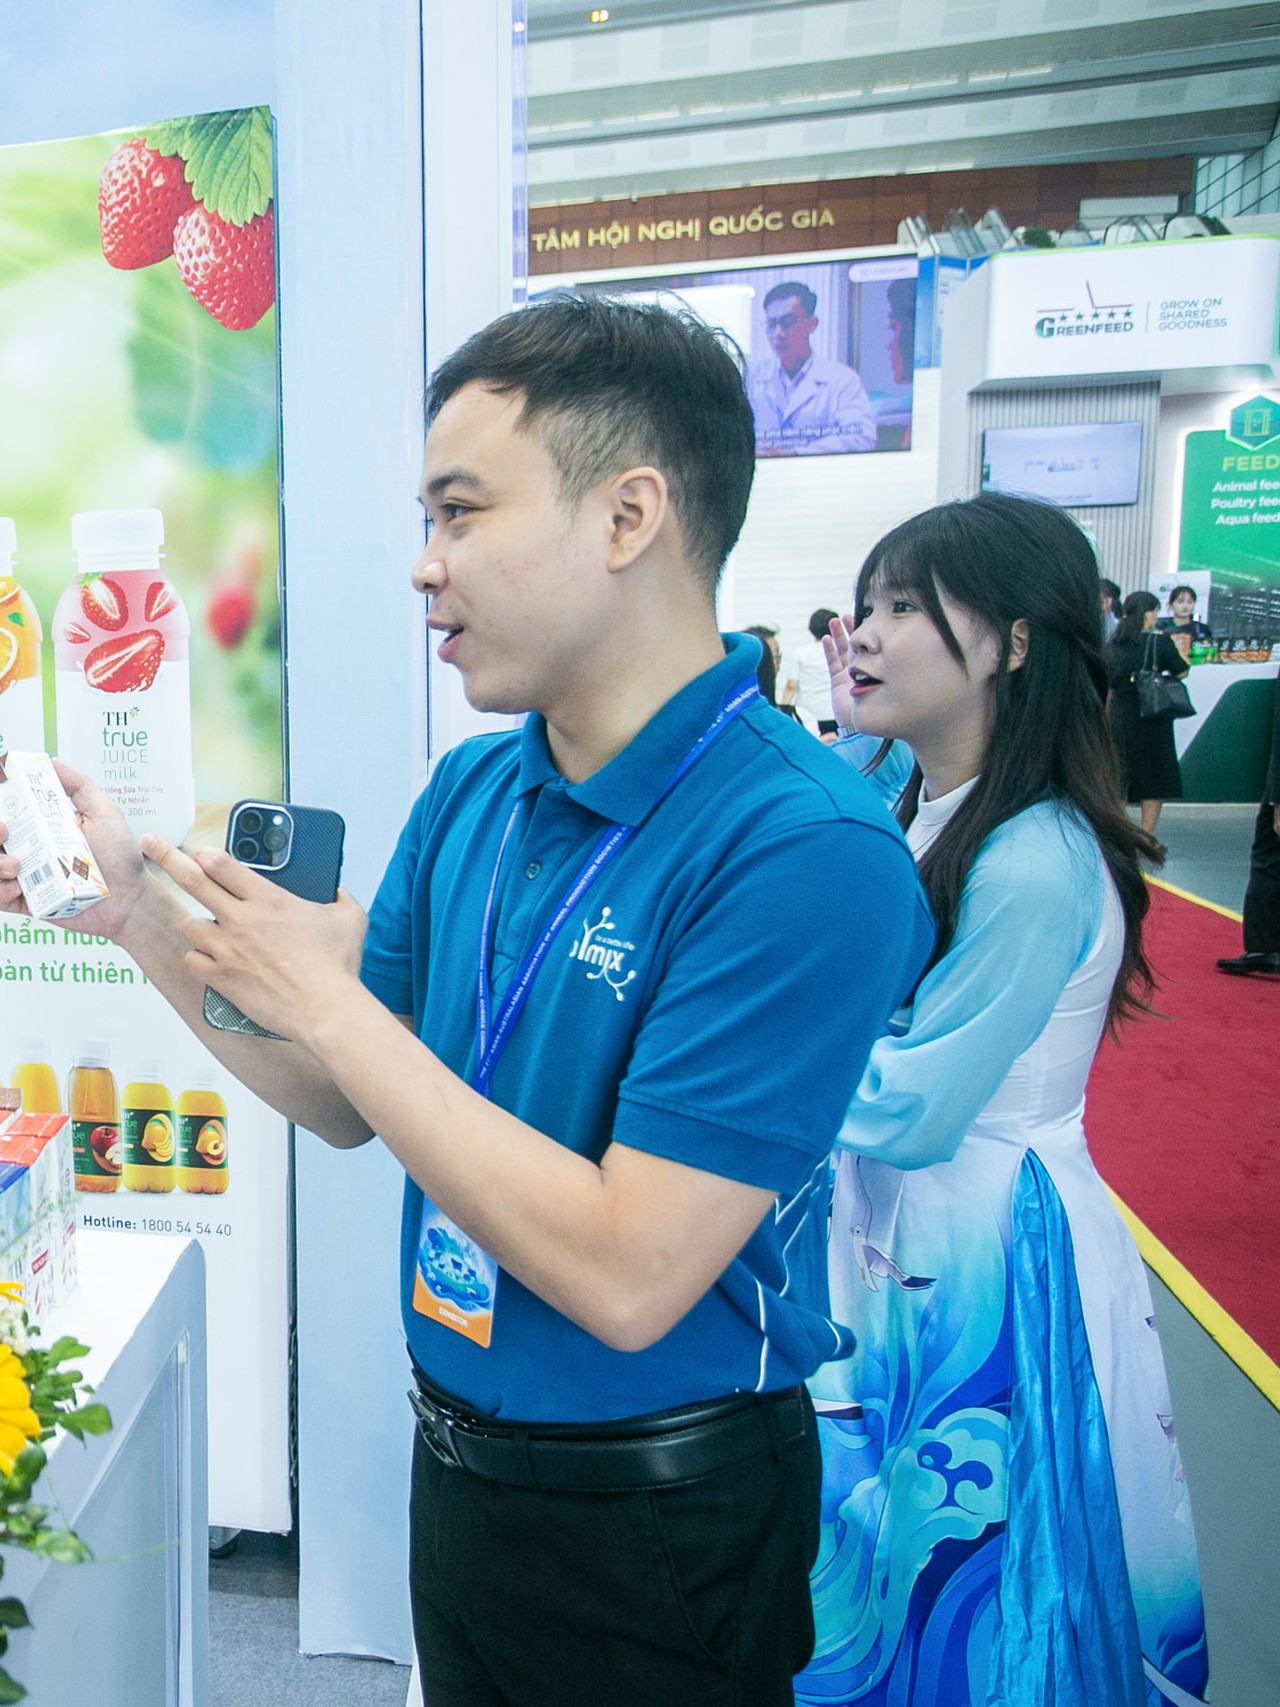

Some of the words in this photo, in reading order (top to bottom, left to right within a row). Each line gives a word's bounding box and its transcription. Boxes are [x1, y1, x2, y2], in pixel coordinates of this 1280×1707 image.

[531, 228, 580, 252] TÂM
[587, 220, 630, 250] HỘI
[638, 218, 701, 242] NGHỊ
[708, 205, 783, 236] QUỐC
[791, 208, 835, 229] GIA
[1160, 300, 1199, 311] GROW
[1203, 298, 1223, 308] ON
[1160, 310, 1210, 321] SHARED
[1035, 317, 1134, 339] GREENFEED
[1159, 318, 1228, 331] GOODNESS
[1222, 454, 1280, 472] FEED
[1212, 480, 1257, 492] Animal
[1260, 478, 1280, 490] fee
[1211, 496, 1257, 509] Poultry
[1259, 495, 1280, 507] fee
[1215, 514, 1250, 526] Aqua
[103, 711, 127, 726] TH
[102, 727, 148, 747] true
[101, 749, 148, 763] JUICE
[105, 766, 137, 780] milk
[128, 807, 143, 816] 300
[40, 960, 66, 982] từ
[72, 961, 134, 984] thiên
[84, 1215, 137, 1230] Hotline:
[142, 1219, 172, 1232] 1800
[176, 1221, 191, 1233] 54
[196, 1222, 211, 1234] 54
[216, 1224, 232, 1236] 40
